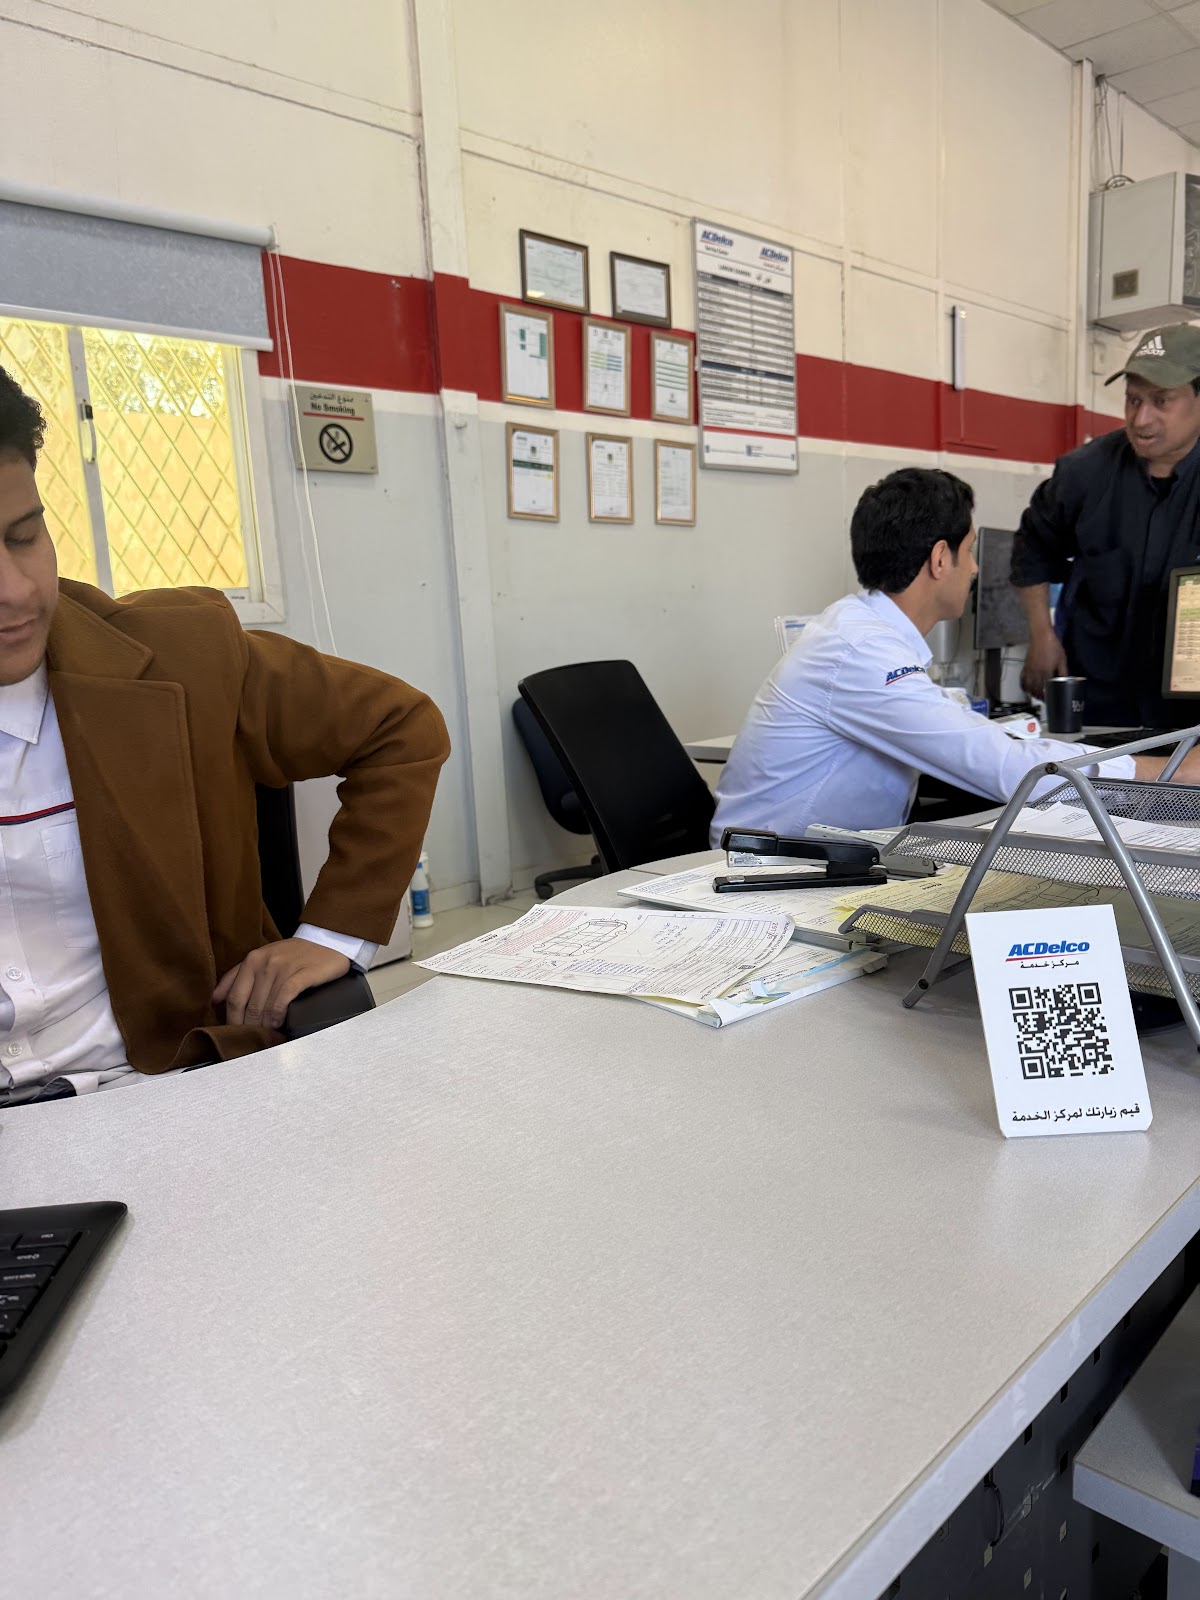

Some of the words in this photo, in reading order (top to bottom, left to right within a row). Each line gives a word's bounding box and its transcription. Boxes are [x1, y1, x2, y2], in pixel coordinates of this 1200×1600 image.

[311, 402, 322, 411] No
[324, 404, 355, 416] Smoking
[1008, 940, 1090, 957] ACDelco
[1020, 961, 1050, 969] خدمة
[1051, 959, 1080, 969] مركز
[1012, 1110, 1051, 1122] الخدمة
[1053, 1108, 1083, 1122] لمركز
[1085, 1106, 1117, 1118] زيارتك
[1119, 1103, 1141, 1119] قيم
